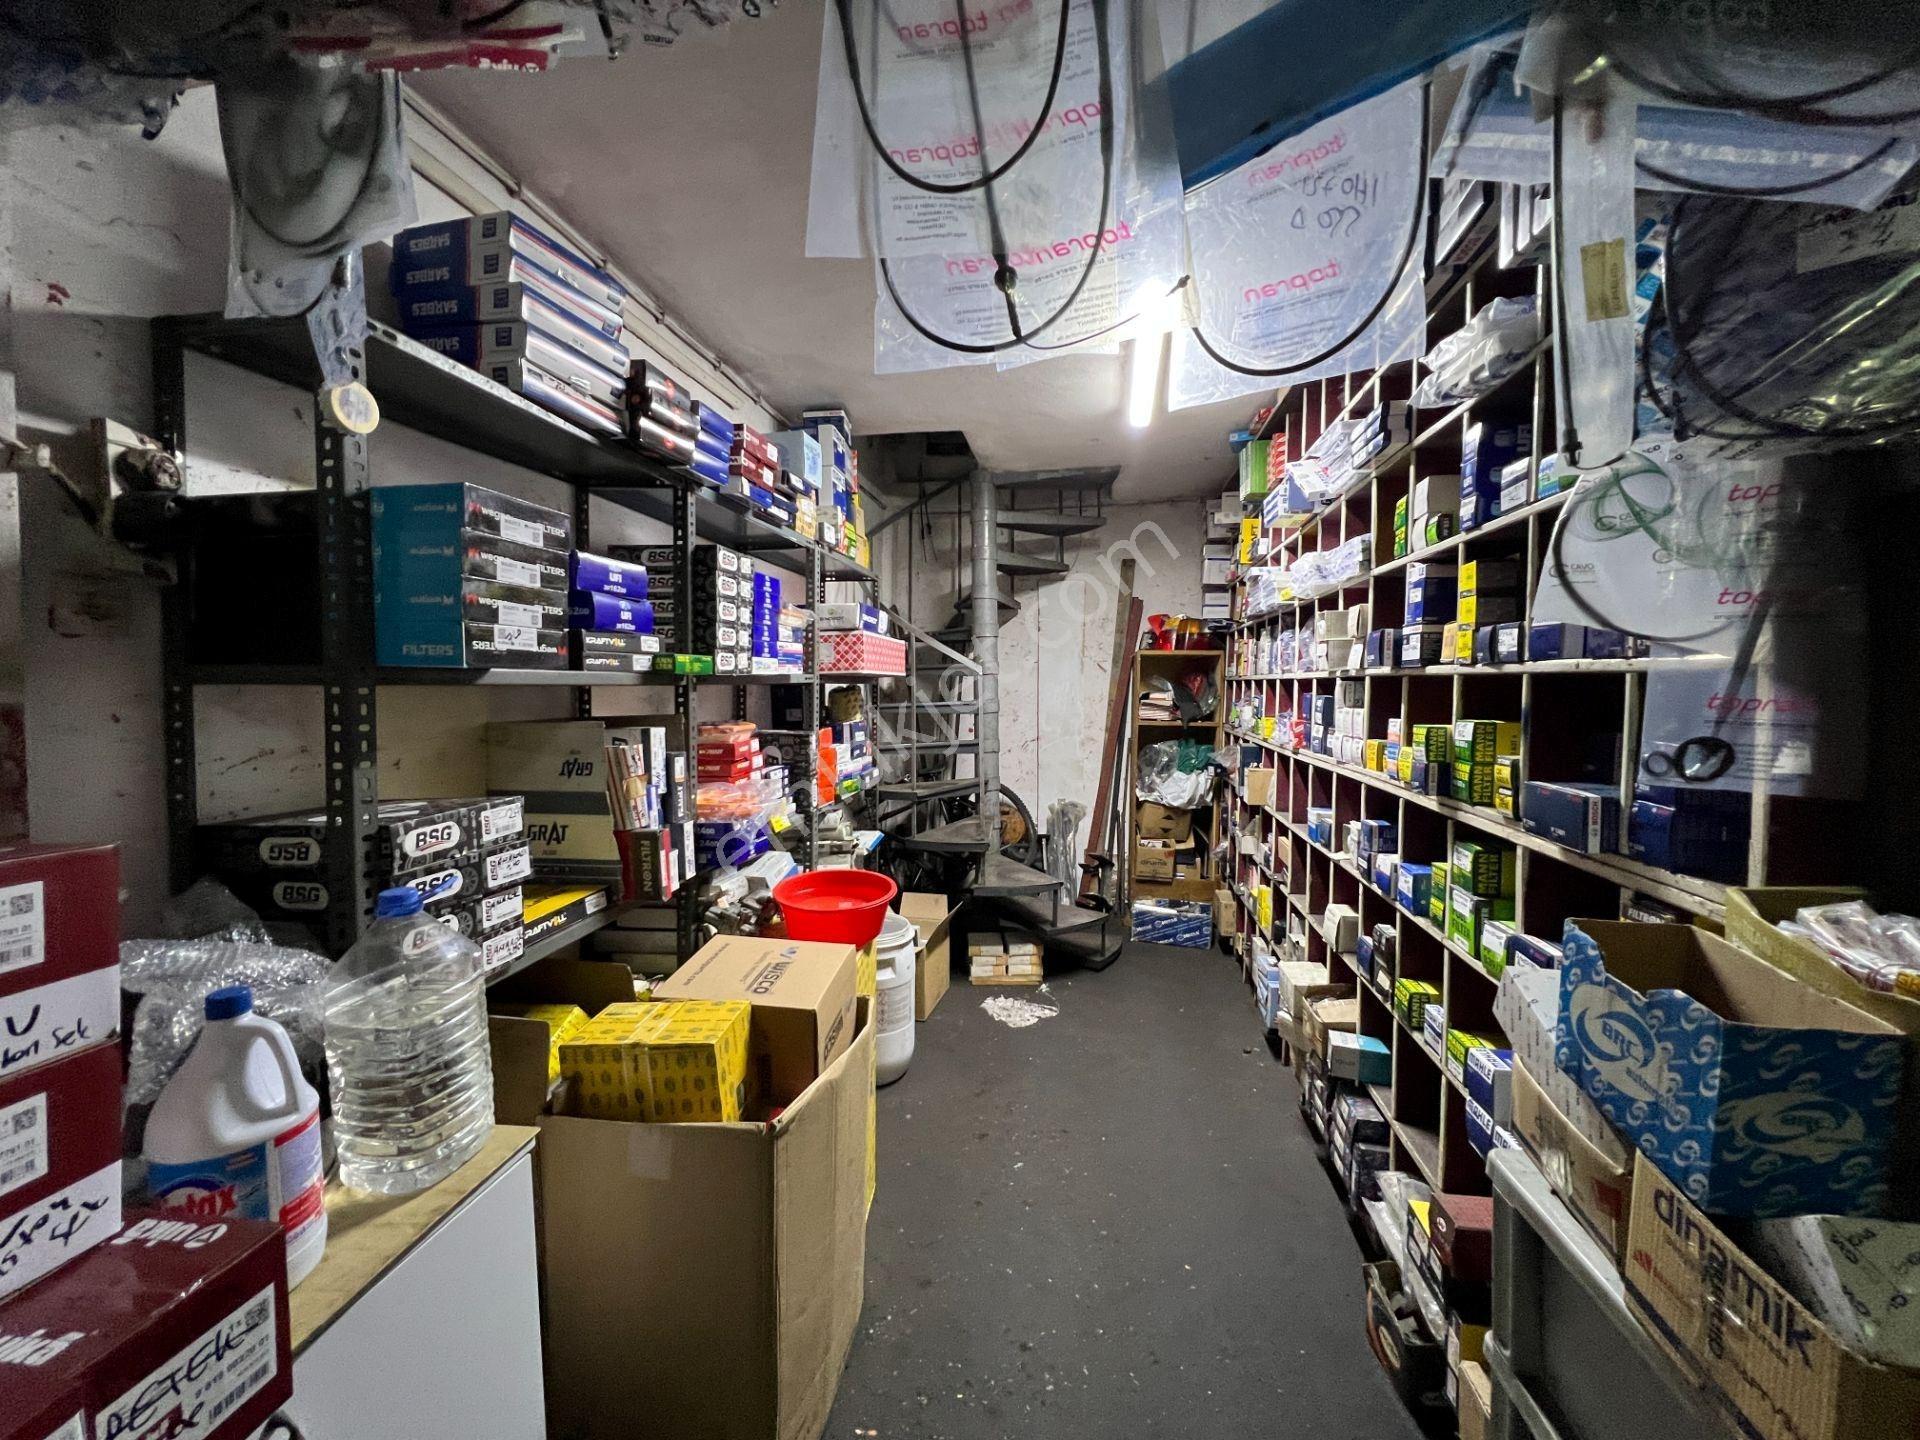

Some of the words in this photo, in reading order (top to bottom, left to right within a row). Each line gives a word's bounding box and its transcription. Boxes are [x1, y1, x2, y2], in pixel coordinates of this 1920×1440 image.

[647, 550, 674, 562] BSG
[402, 644, 454, 657] FILTERS
[1428, 726, 1438, 762] MANN
[1438, 728, 1447, 762] FILTER
[1476, 724, 1487, 762] MANN
[1487, 723, 1496, 762] FILTER
[1473, 763, 1482, 803] MANN
[1482, 764, 1494, 804] FILTER
[1591, 800, 1599, 827] BOSCH
[415, 825, 453, 851] BSG
[526, 821, 569, 846] GRAT
[268, 842, 311, 862] BSG
[640, 840, 653, 893] FILTRON
[489, 859, 499, 882] BSG
[1477, 852, 1488, 895] MANN
[1488, 852, 1499, 896] FILTER
[281, 885, 322, 905] BSG
[1627, 906, 1667, 924] FILTRON
[753, 959, 791, 994] WISCO
[1411, 992, 1419, 1028] MANN
[1601, 1019, 1640, 1062] BRC
[1469, 1053, 1493, 1083] MAHLE
[1466, 1098, 1493, 1133] MAHLE
